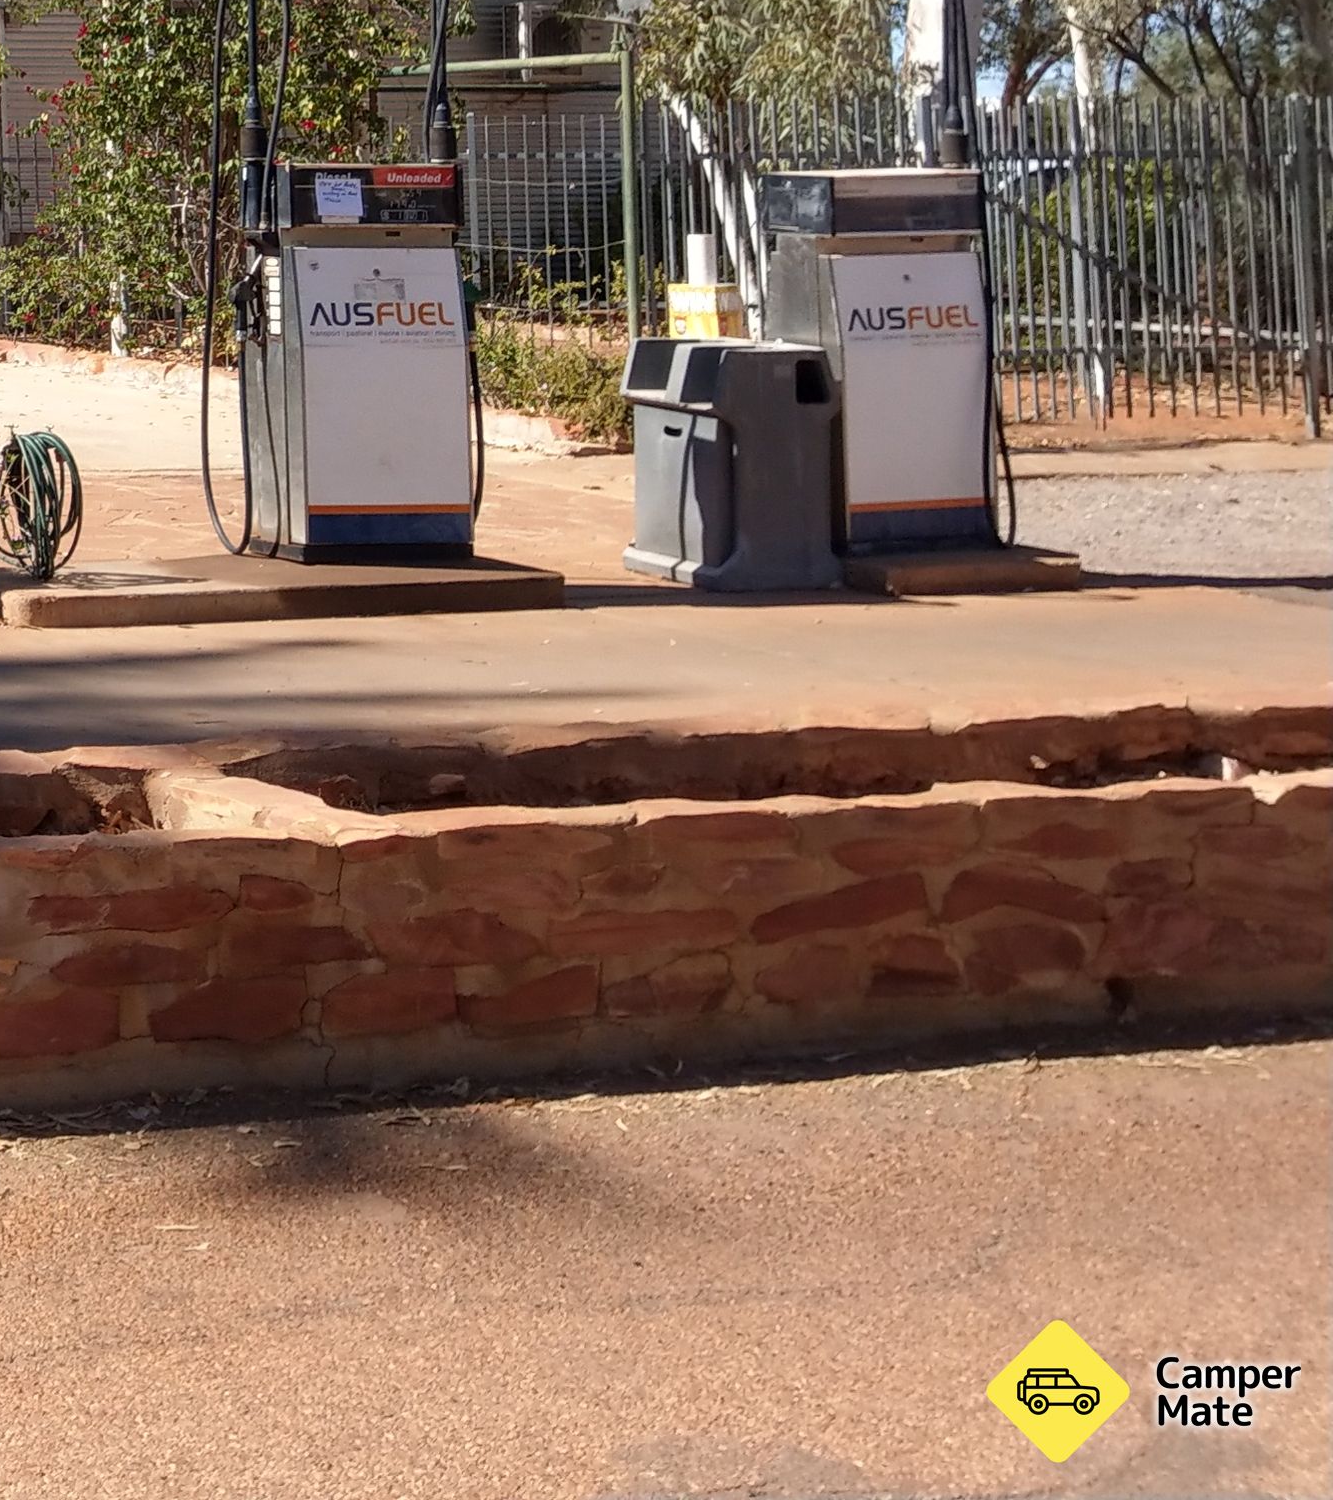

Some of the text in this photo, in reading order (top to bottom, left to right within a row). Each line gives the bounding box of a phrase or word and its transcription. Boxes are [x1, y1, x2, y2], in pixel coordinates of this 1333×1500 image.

[387, 173, 442, 183] Unleaded
[309, 302, 455, 326] AUSFUEL
[848, 304, 979, 332] AUSFUEL
[310, 330, 340, 338] transport
